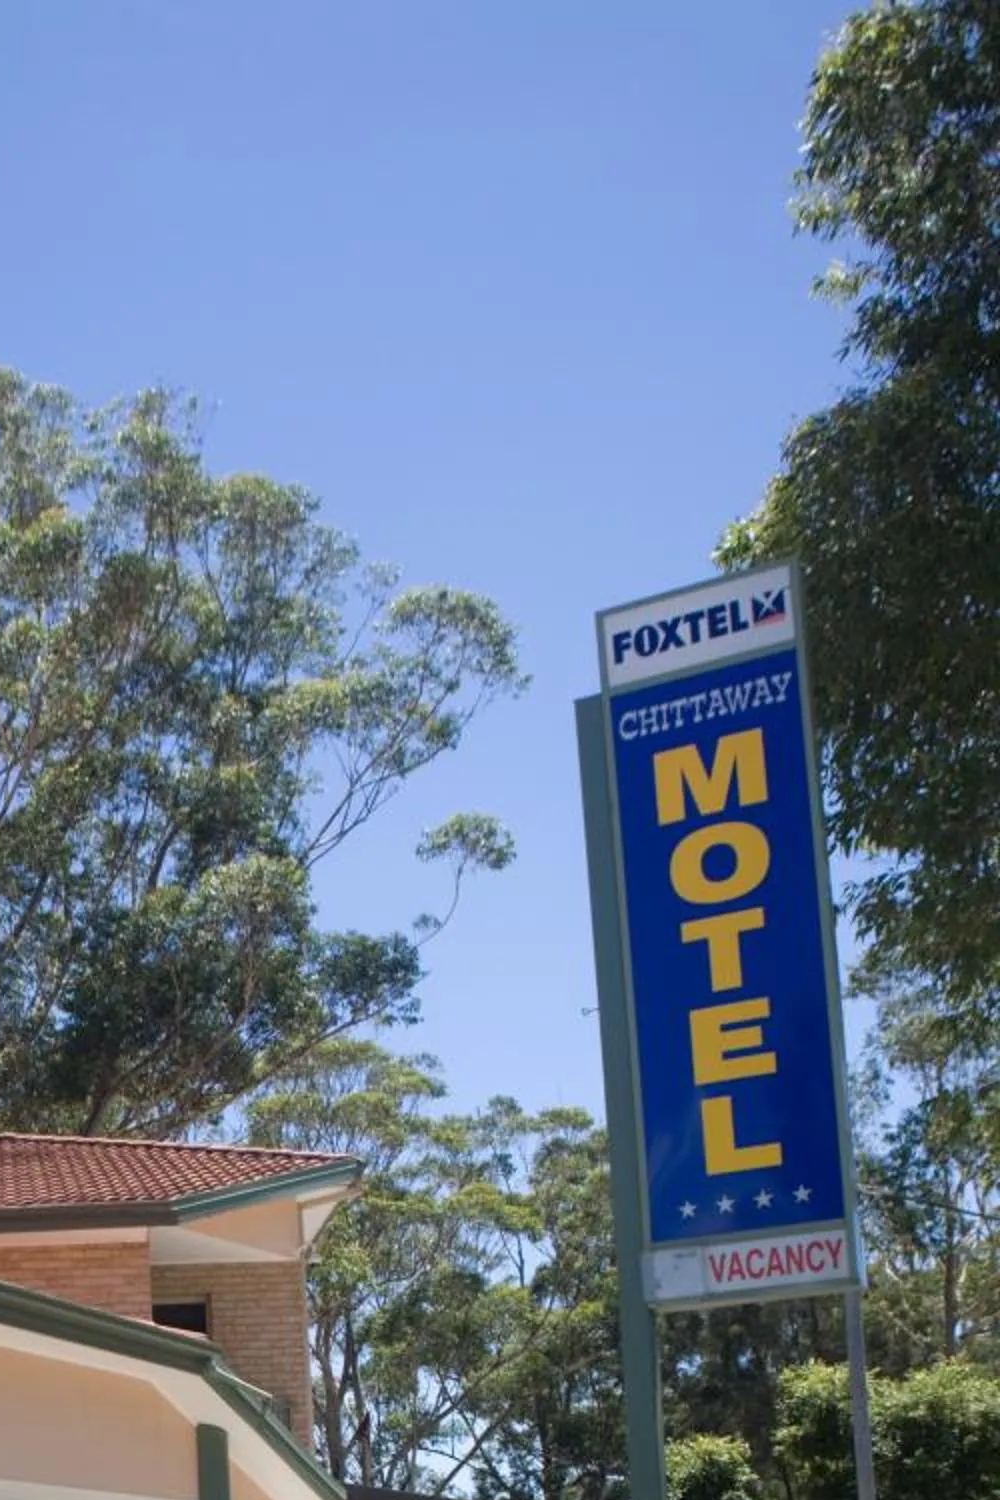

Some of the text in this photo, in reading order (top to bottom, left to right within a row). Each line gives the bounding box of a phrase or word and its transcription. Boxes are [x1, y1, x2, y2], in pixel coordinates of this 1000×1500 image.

[613, 600, 749, 664] FOXTEL
[619, 671, 792, 741] CHITTAWAY
[653, 727, 783, 1176] MOTEL
[708, 1238, 843, 1284] VACANCY
